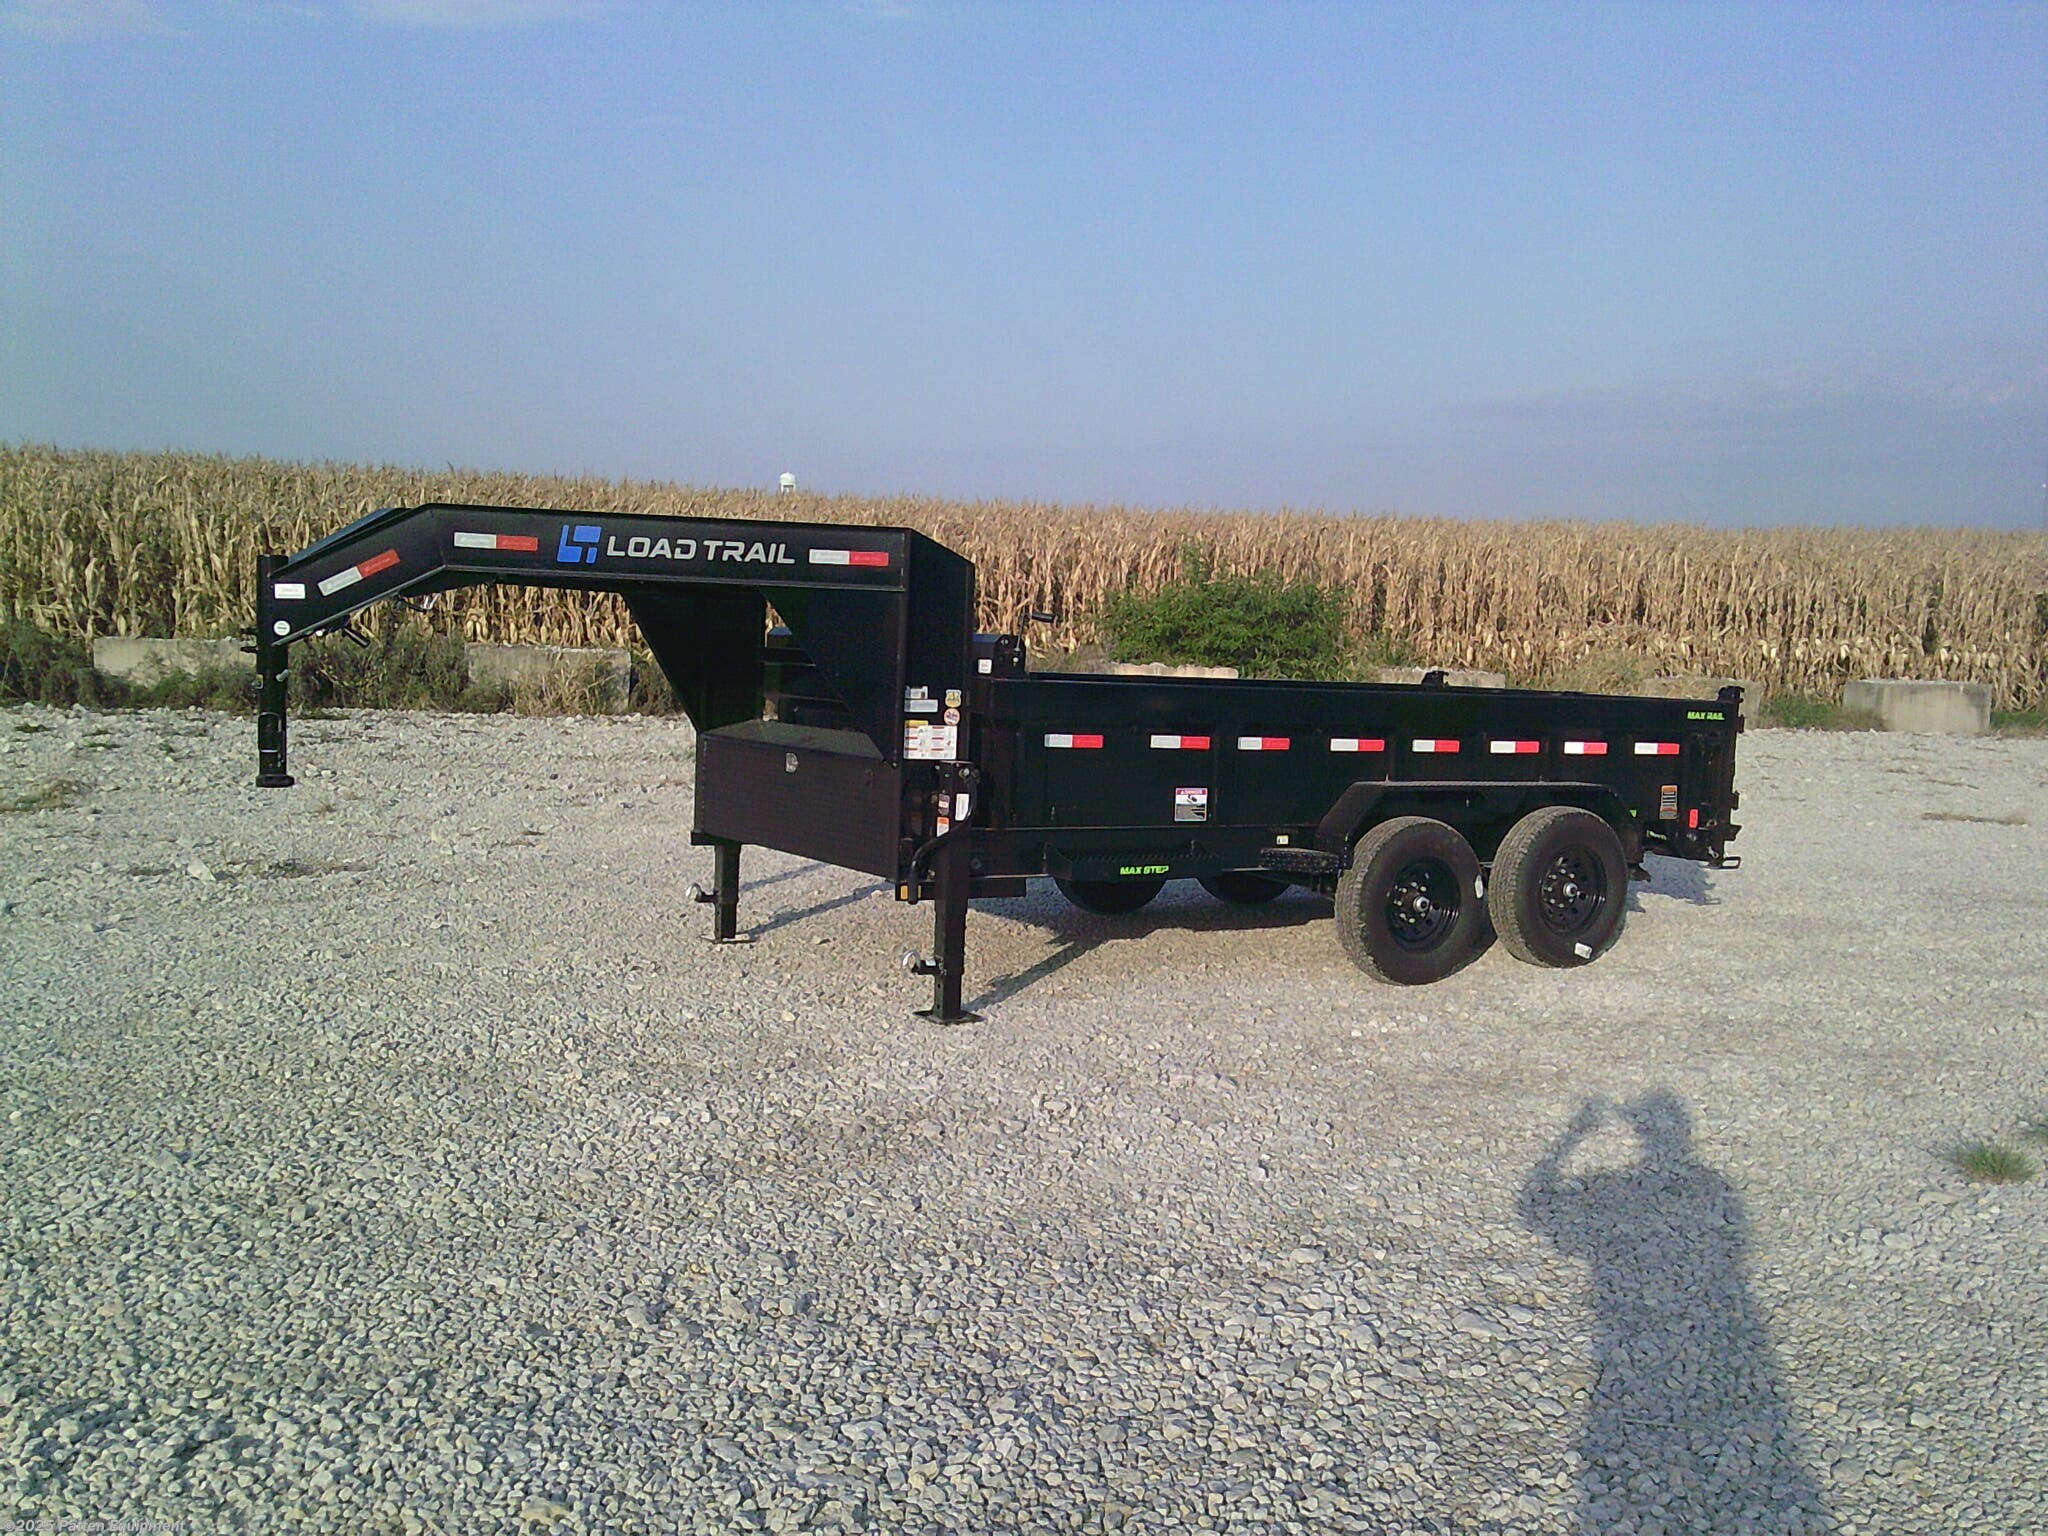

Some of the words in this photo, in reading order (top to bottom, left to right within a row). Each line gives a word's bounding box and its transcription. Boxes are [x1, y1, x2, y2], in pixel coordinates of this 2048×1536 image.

[606, 535, 697, 560] LOAD
[702, 539, 796, 564] TRAIL
[1119, 866, 1142, 875] MAX
[1143, 865, 1169, 874] STEP
